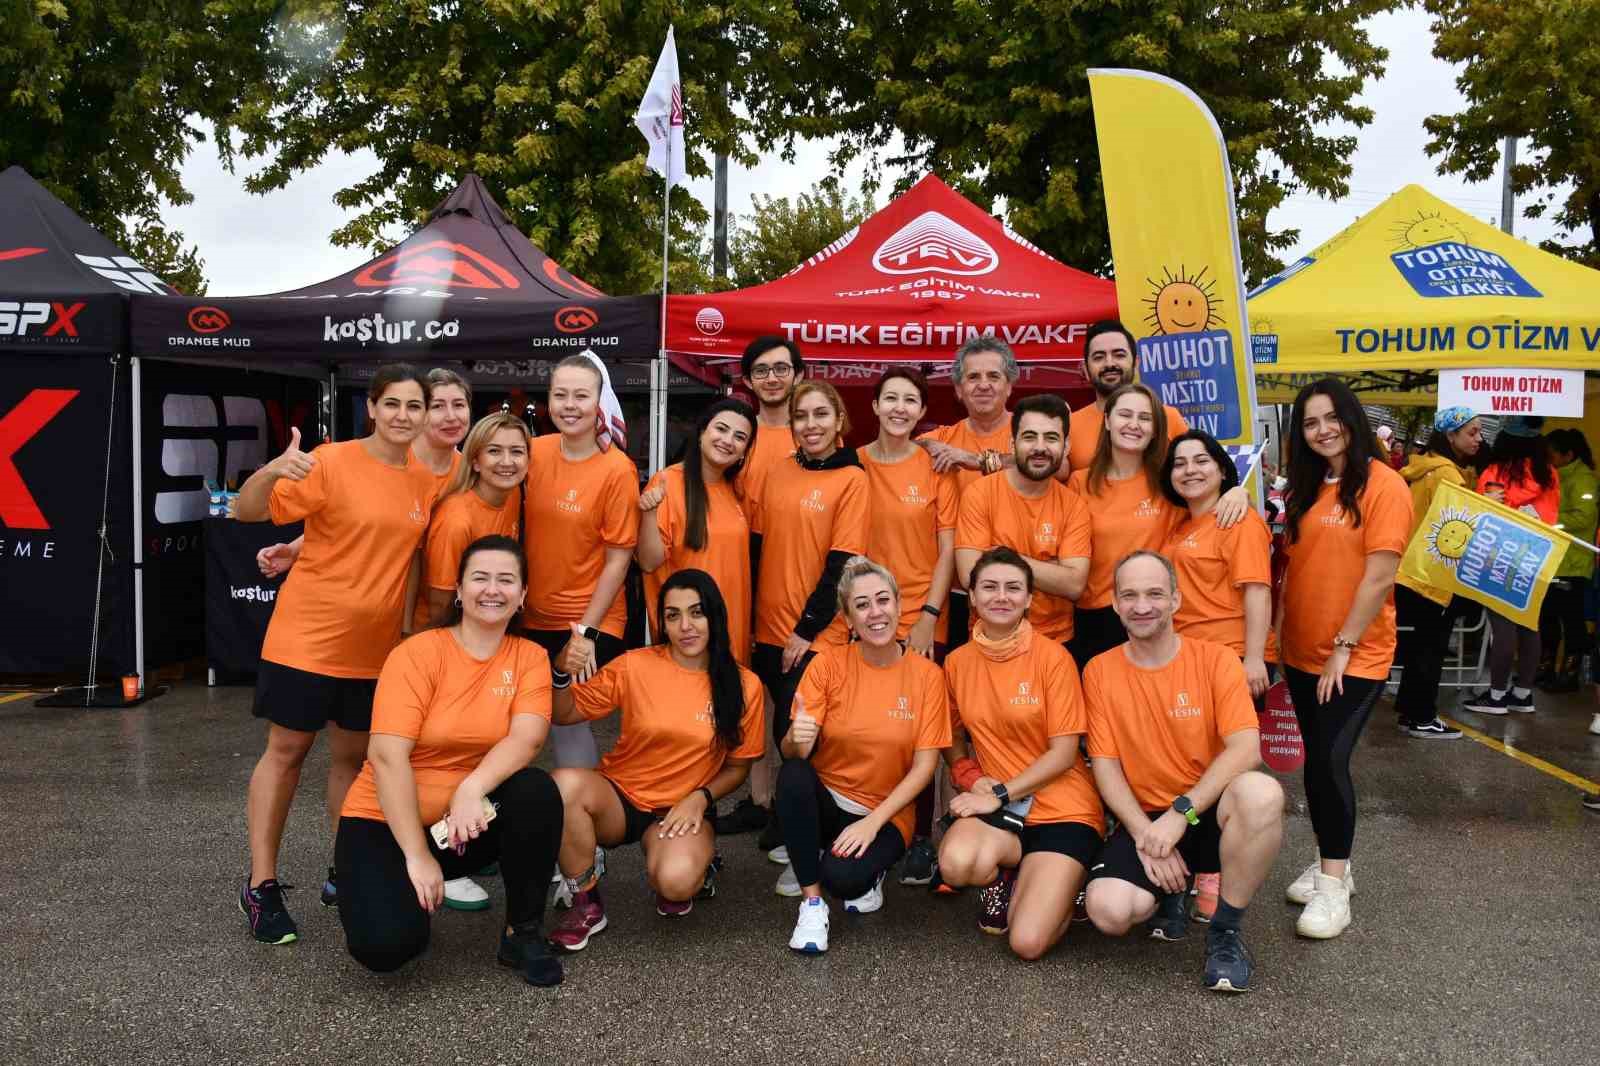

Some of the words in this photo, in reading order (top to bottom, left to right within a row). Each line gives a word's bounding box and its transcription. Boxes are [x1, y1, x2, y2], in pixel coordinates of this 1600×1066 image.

[888, 242, 985, 267] TEV
[1394, 244, 1509, 269] TOHUM
[1440, 283, 1519, 296] VAKFI
[699, 321, 721, 330] TEV
[780, 319, 871, 345] TÜRK
[1000, 324, 1094, 344] VAKF
[168, 337, 219, 347] ORANGE
[223, 337, 251, 347] MUD
[533, 337, 587, 347] ORANGE
[590, 336, 619, 346] MUD
[1251, 335, 1277, 345] TOHUM
[1336, 326, 1456, 354] TOHUM
[1461, 375, 1515, 392] TOHUM
[1491, 394, 1534, 413] VAKFI
